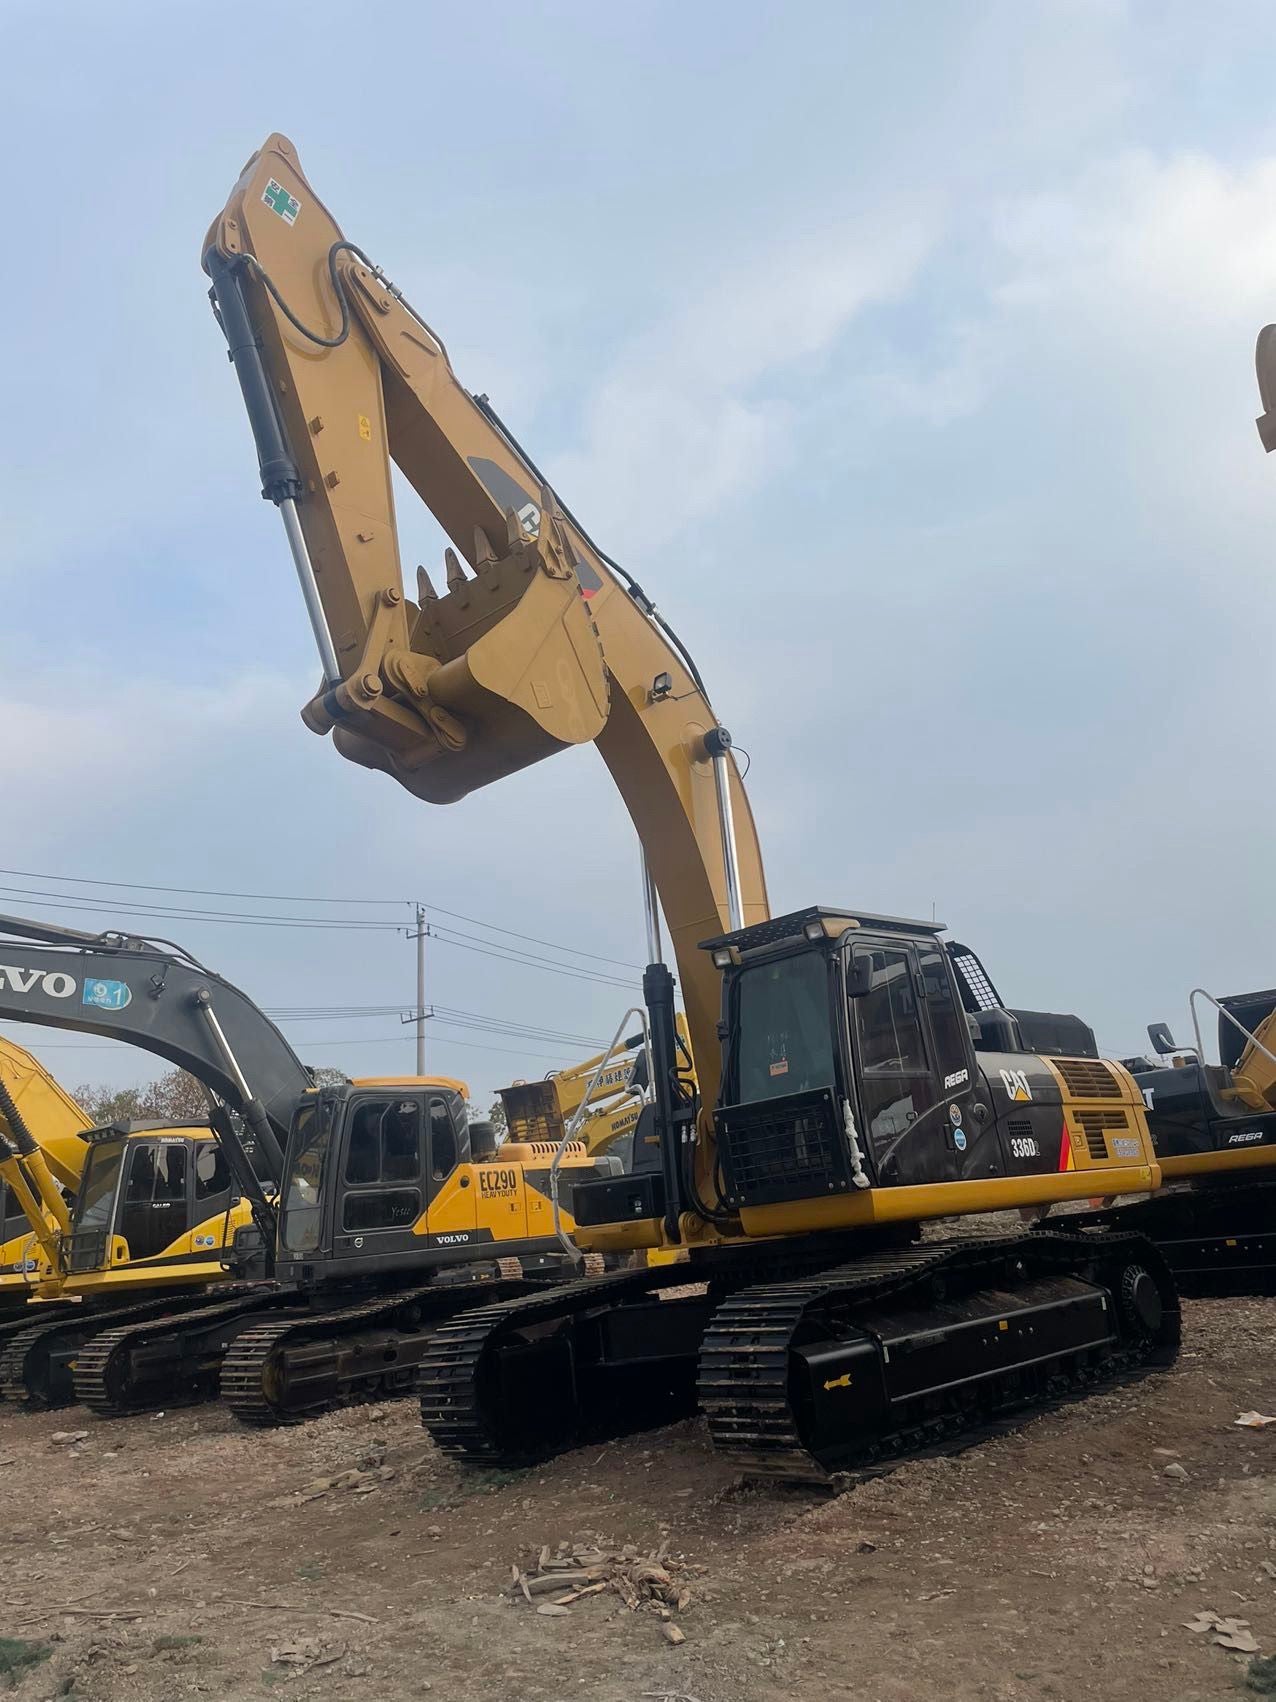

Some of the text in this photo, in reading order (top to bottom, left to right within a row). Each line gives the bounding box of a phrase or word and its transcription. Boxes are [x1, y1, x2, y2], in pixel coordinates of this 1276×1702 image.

[944, 1068, 969, 1090] REGA
[999, 1069, 1032, 1101] CAT
[611, 1111, 639, 1132] KOMATSU
[1228, 1131, 1263, 1144] REGA
[479, 1169, 516, 1191] EC290
[436, 1234, 469, 1244] VOLVO
